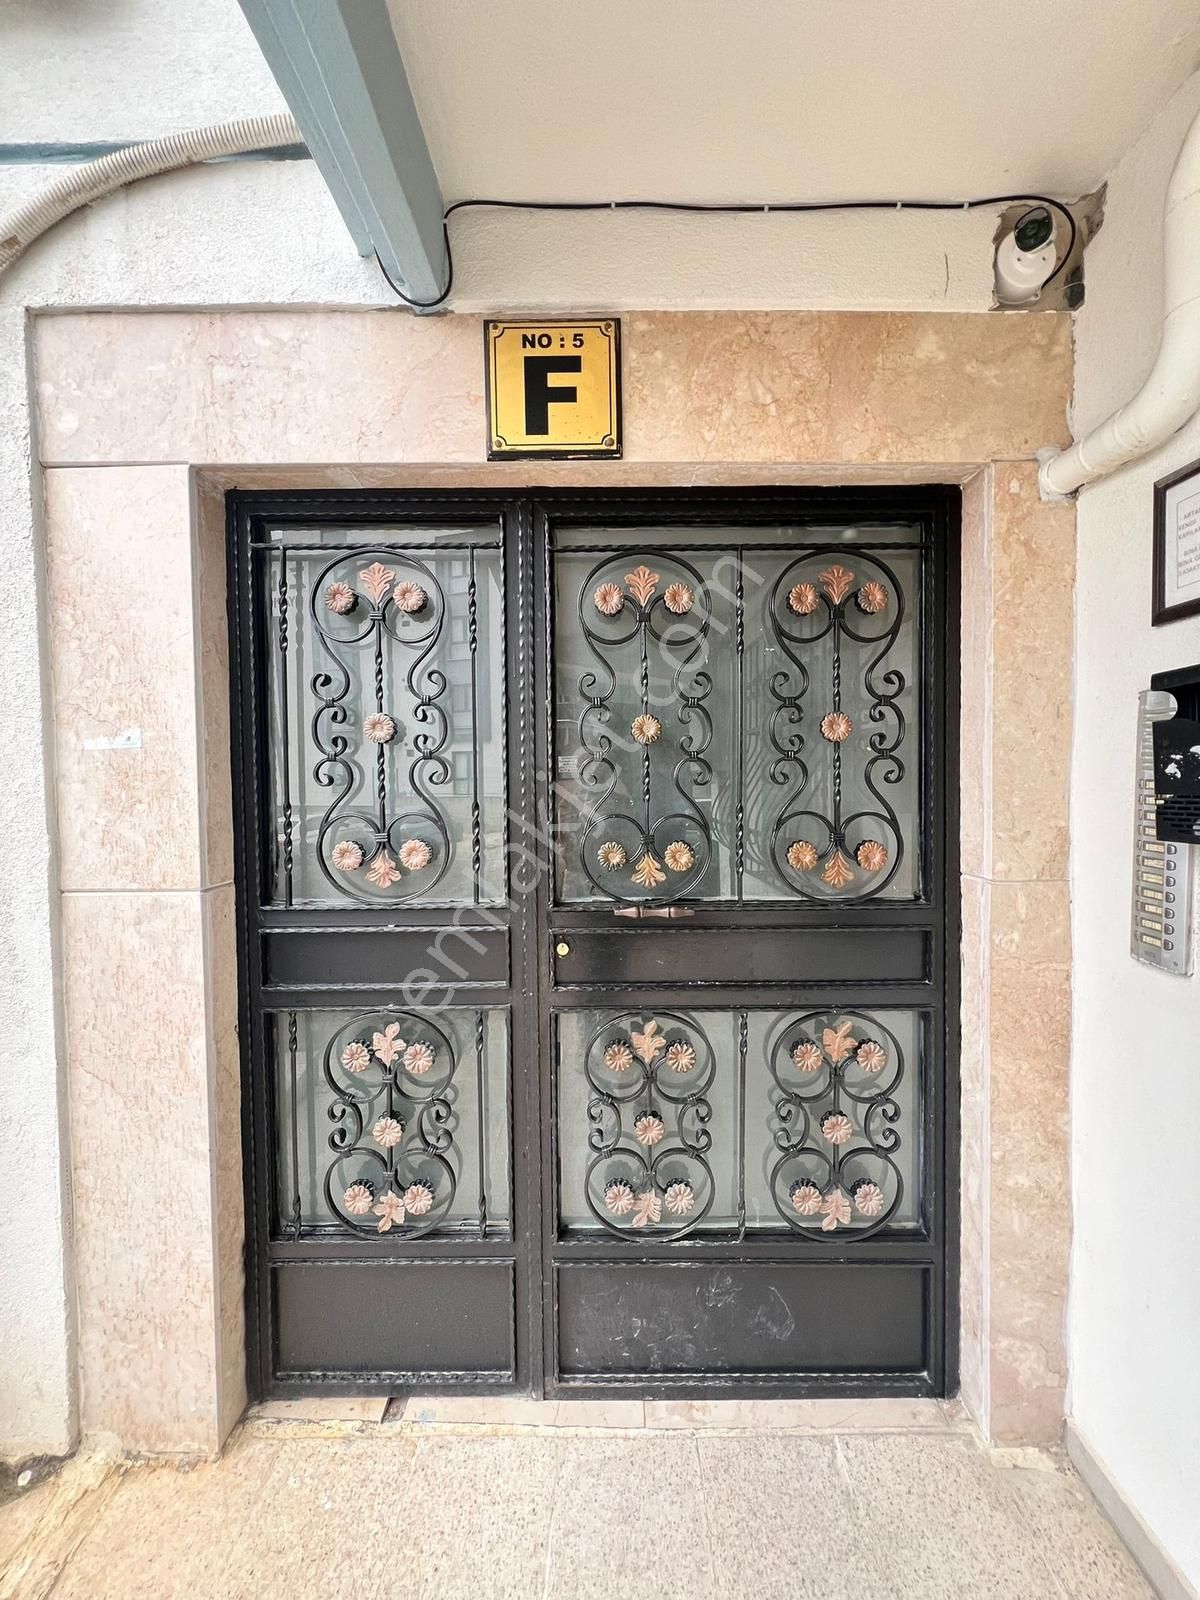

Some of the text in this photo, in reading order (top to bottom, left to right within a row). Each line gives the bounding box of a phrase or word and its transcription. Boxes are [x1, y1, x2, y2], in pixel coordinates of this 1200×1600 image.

[522, 334, 552, 348] NO
[572, 334, 585, 348] 5
[524, 356, 581, 435] F
